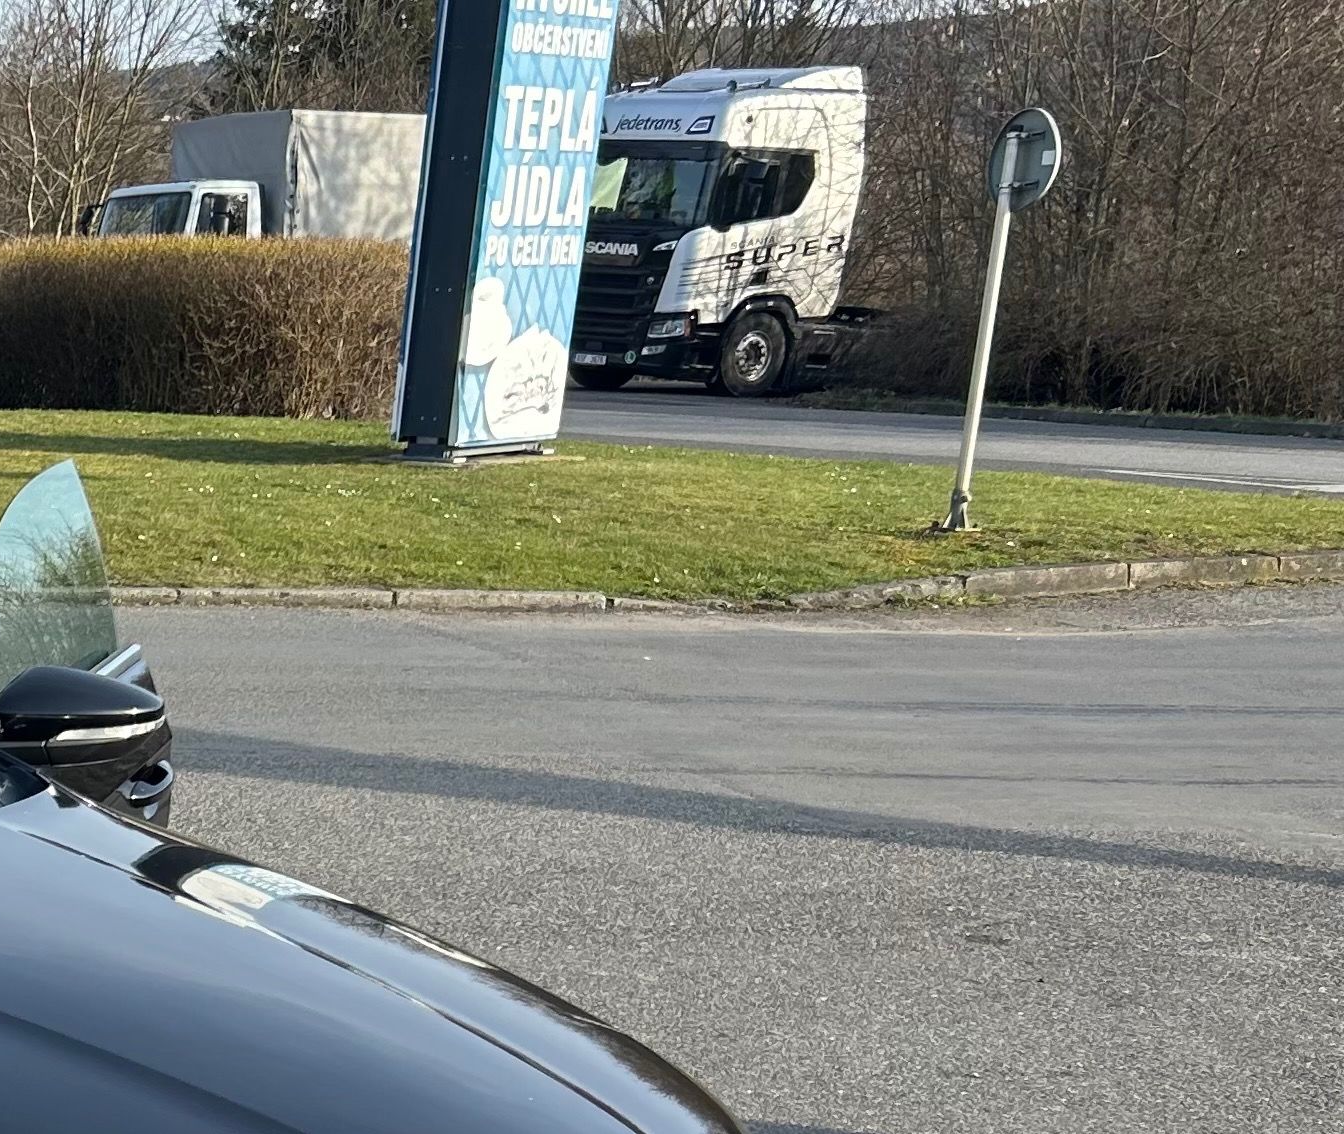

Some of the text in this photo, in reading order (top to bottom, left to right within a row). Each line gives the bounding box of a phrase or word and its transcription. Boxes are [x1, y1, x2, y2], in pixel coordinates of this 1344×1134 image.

[512, 17, 611, 60] OBČERSTVENÍ
[503, 76, 599, 152] TEPLÁ
[490, 152, 587, 227] JÍDLA
[484, 230, 580, 267] PO CELÝ DEN
[585, 241, 638, 256] SCANIA
[724, 235, 844, 270] SUPER
